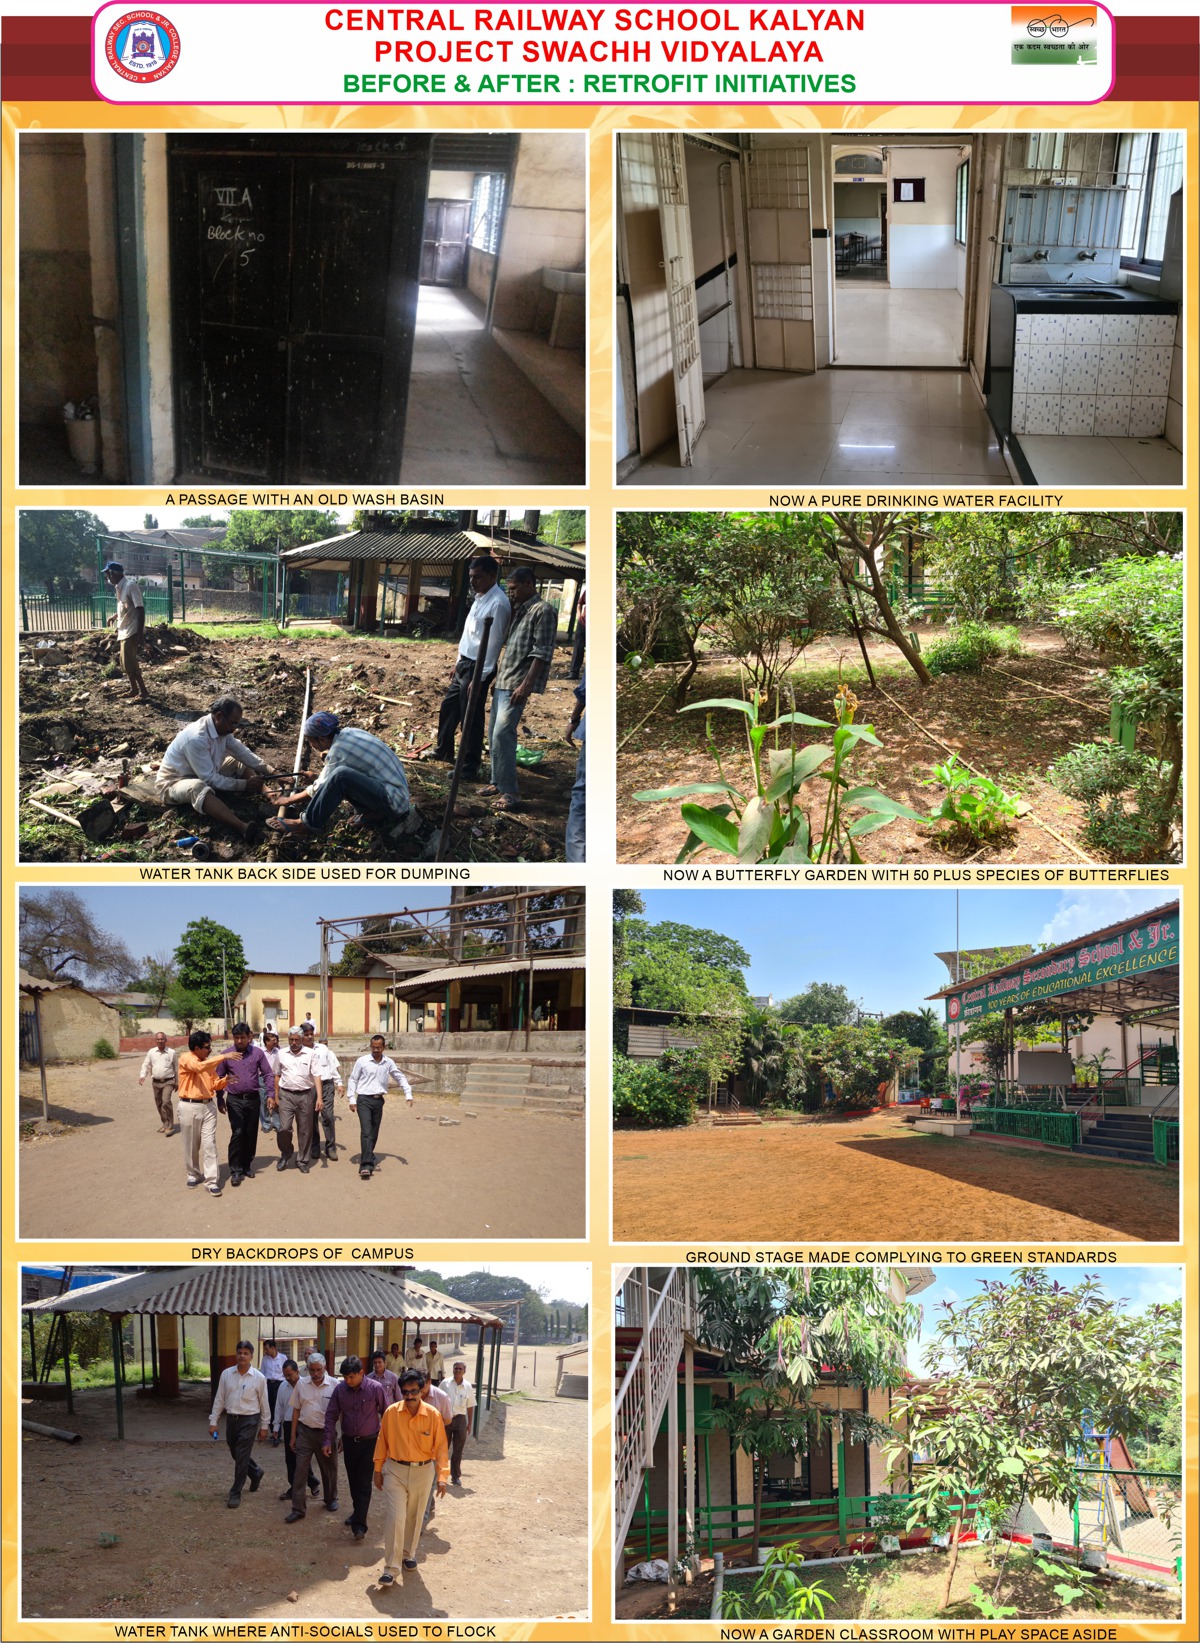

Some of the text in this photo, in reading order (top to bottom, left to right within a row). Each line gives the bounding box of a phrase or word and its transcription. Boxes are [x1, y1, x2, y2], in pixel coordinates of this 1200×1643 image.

[127, 12, 154, 20] SCHOOL
[161, 19, 170, 28] JR.
[325, 8, 864, 31] CENTRAL RAILWAY SCHOOL KALYAN
[113, 19, 126, 31] SEC.
[107, 31, 115, 60] RAILWAY
[169, 29, 179, 59] COLLEGE
[375, 40, 824, 63] PROJECT SWACHH VIDYALAYA
[112, 60, 138, 81] CENTRAL
[154, 60, 175, 79] KALYAN
[343, 73, 856, 94] BEFORE & AFTER : RETROFIT INITIATIVES
[215, 187, 252, 211] VII A
[208, 225, 265, 241] Block no
[240, 248, 255, 266] 5
[165, 493, 444, 506] A PASSAGE WITH AN OLD WASH BASIN
[769, 495, 1063, 507] NOW A PURE DRINKING WATER FACILITY
[139, 868, 470, 880] WATER TANK BACK SIDE USED FOR DUMPING
[663, 869, 1169, 881] NOW A BUTTERFLY GARDEN WITH 50 PLUS SPECIES OF BUTTERFLIES
[962, 920, 1175, 1004] Central Railway Secondary School & Jr.
[988, 946, 1177, 1009] 100 YEARS OF EDUCATIONAL EXCELLENCE
[191, 1247, 414, 1260] DRY BACKDROPS OF CAMPUS
[685, 1251, 1117, 1263] GROUND STAGE MADE COMPLYING TO GREEN STANDARDS
[114, 1625, 496, 1637] WATER TANK WHERE ANTI-SOCIALS USED TO FLOCK
[720, 1628, 1117, 1640] NOW A GARDEN CLASSROOM WITH PLAY SPACE ASIDE
